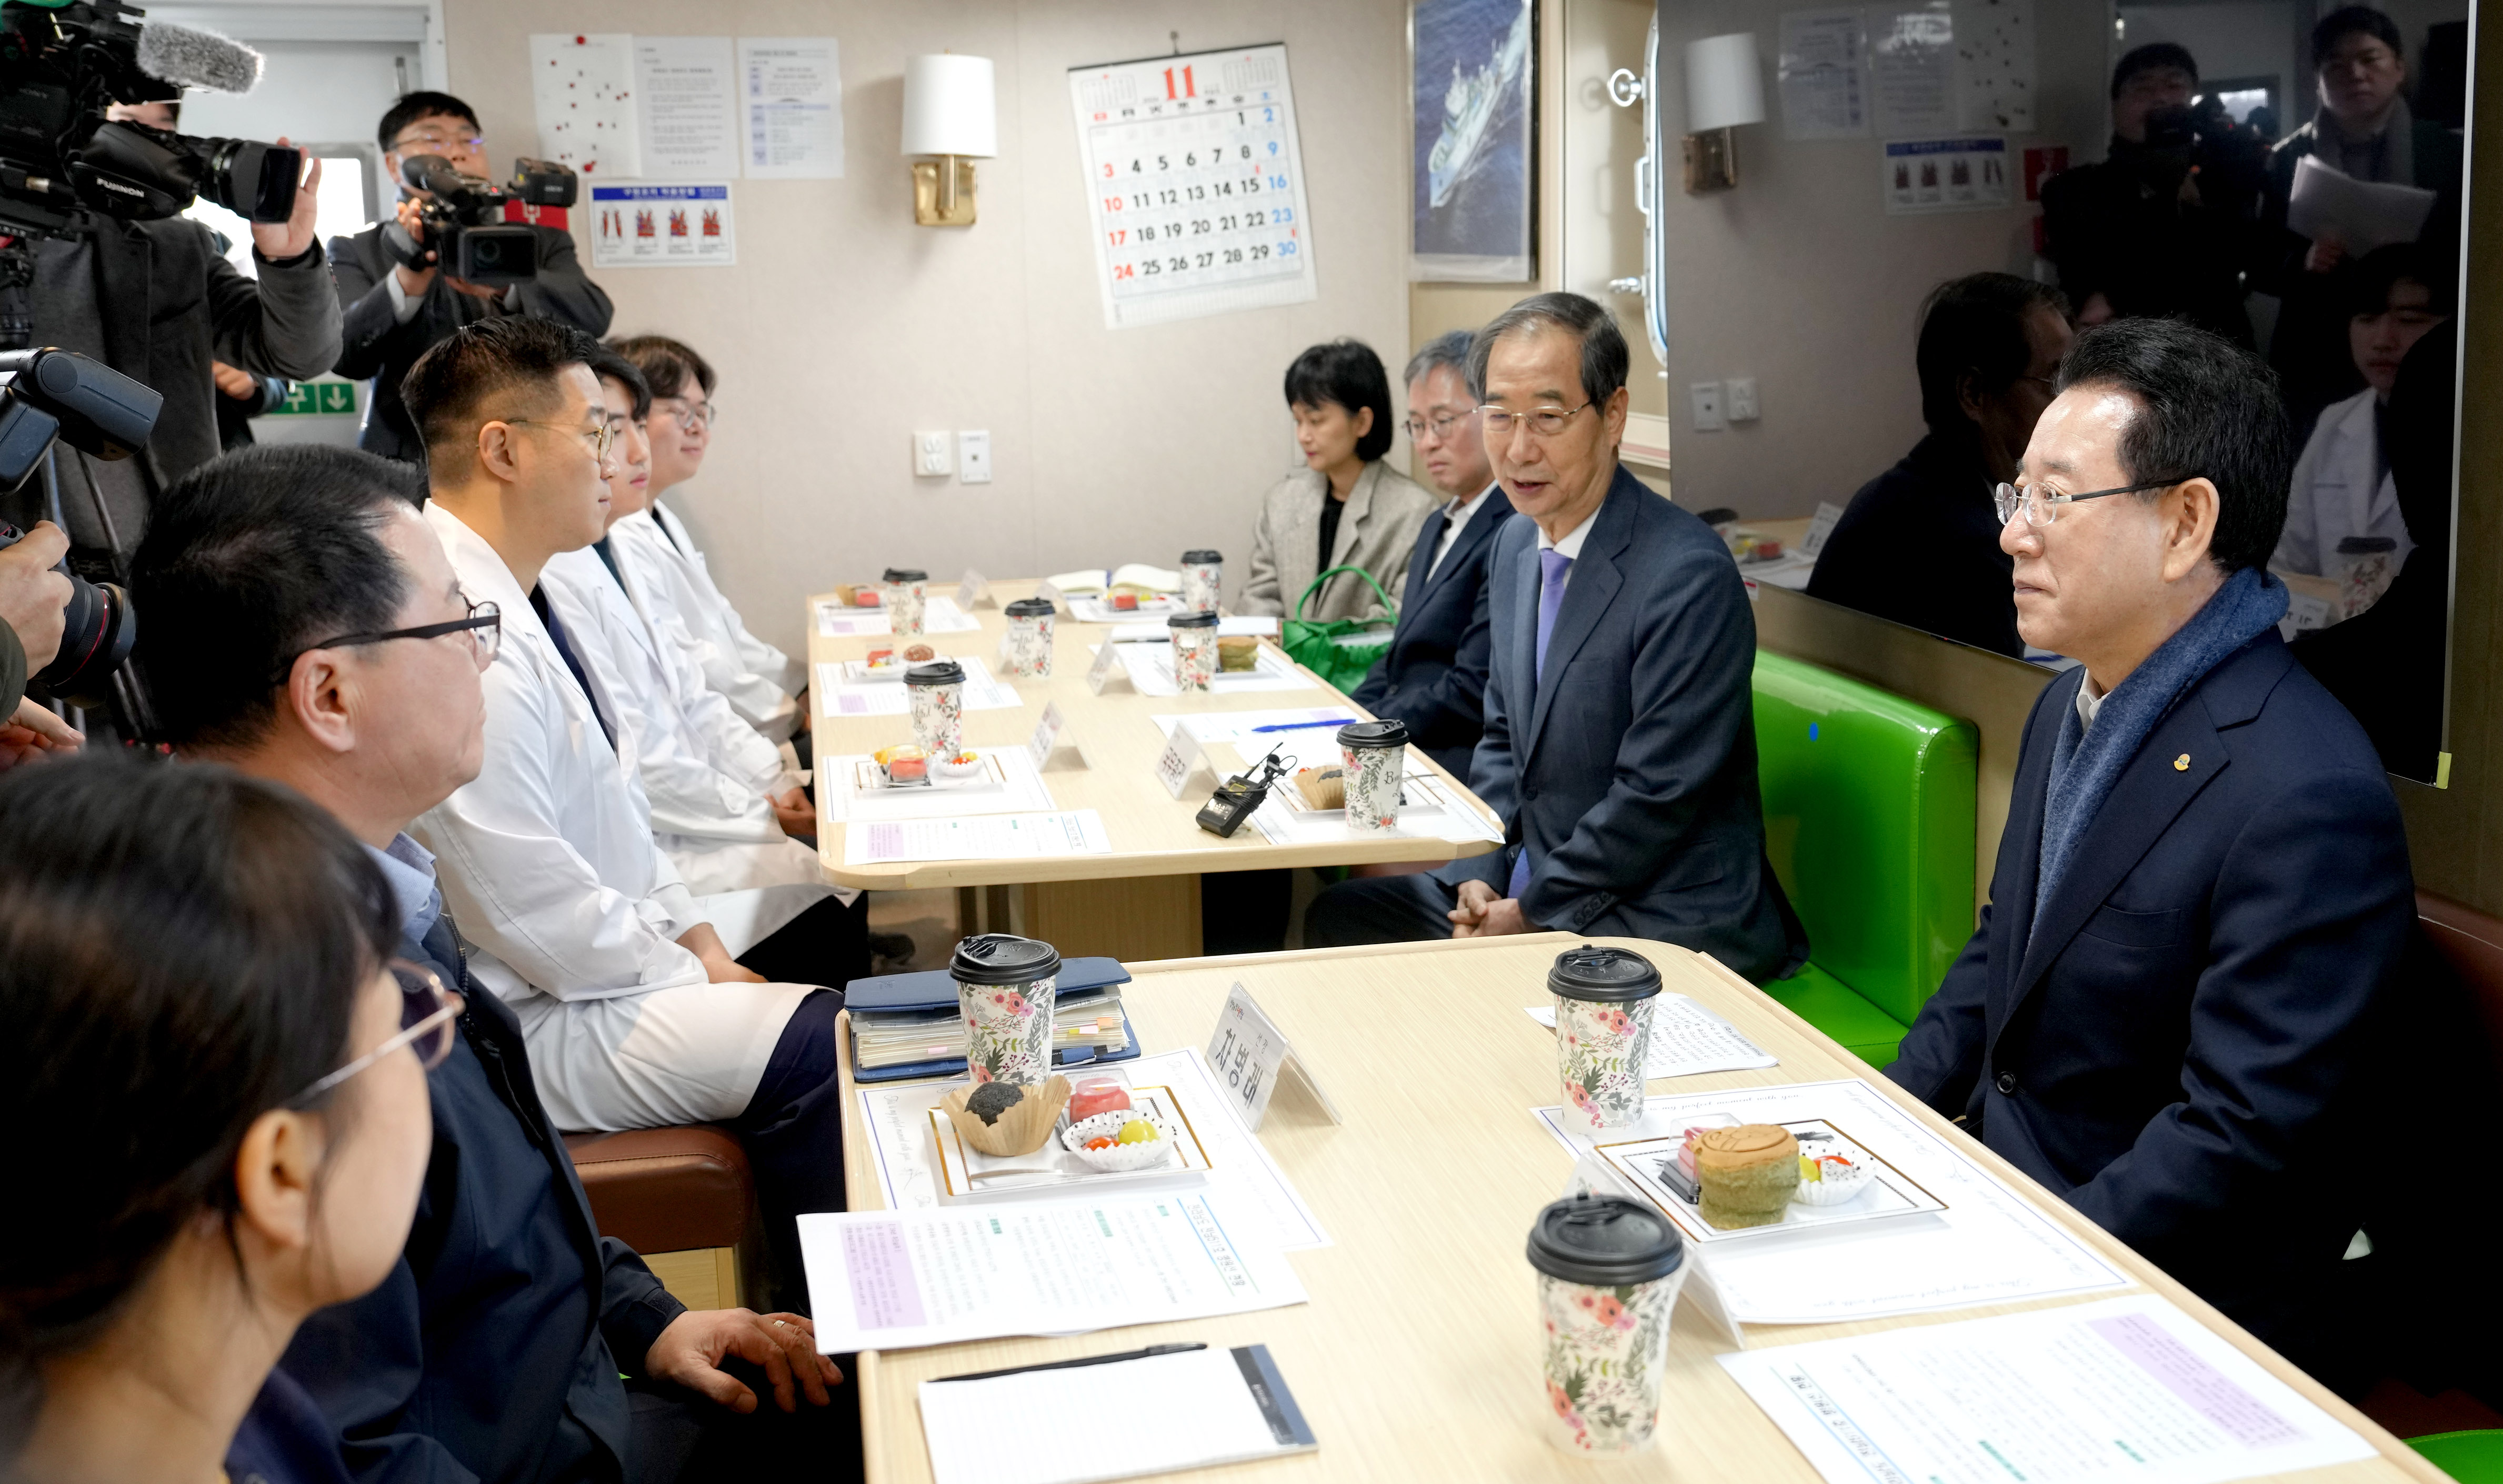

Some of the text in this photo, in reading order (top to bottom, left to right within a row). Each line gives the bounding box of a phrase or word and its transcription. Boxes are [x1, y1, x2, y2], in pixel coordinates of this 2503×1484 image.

[1163, 65, 1197, 101] 11
[1238, 106, 1273, 125] 1 2
[1105, 142, 1277, 177] 3 4 5 6 7 8 9
[96, 177, 145, 198] FUJINON
[1105, 175, 1286, 212] 10 11 12 13 14 15 16
[1109, 208, 1293, 245] 17 18 19 20 21 22 23
[1115, 241, 1296, 279] 24 25 26 27 28 29 30
[1256, 1032, 1268, 1054] 선장
[1215, 1028, 1263, 1110] 차병래
[1681, 1100, 1711, 1109] perfect
[1187, 1204, 1210, 1225] 전라남도
